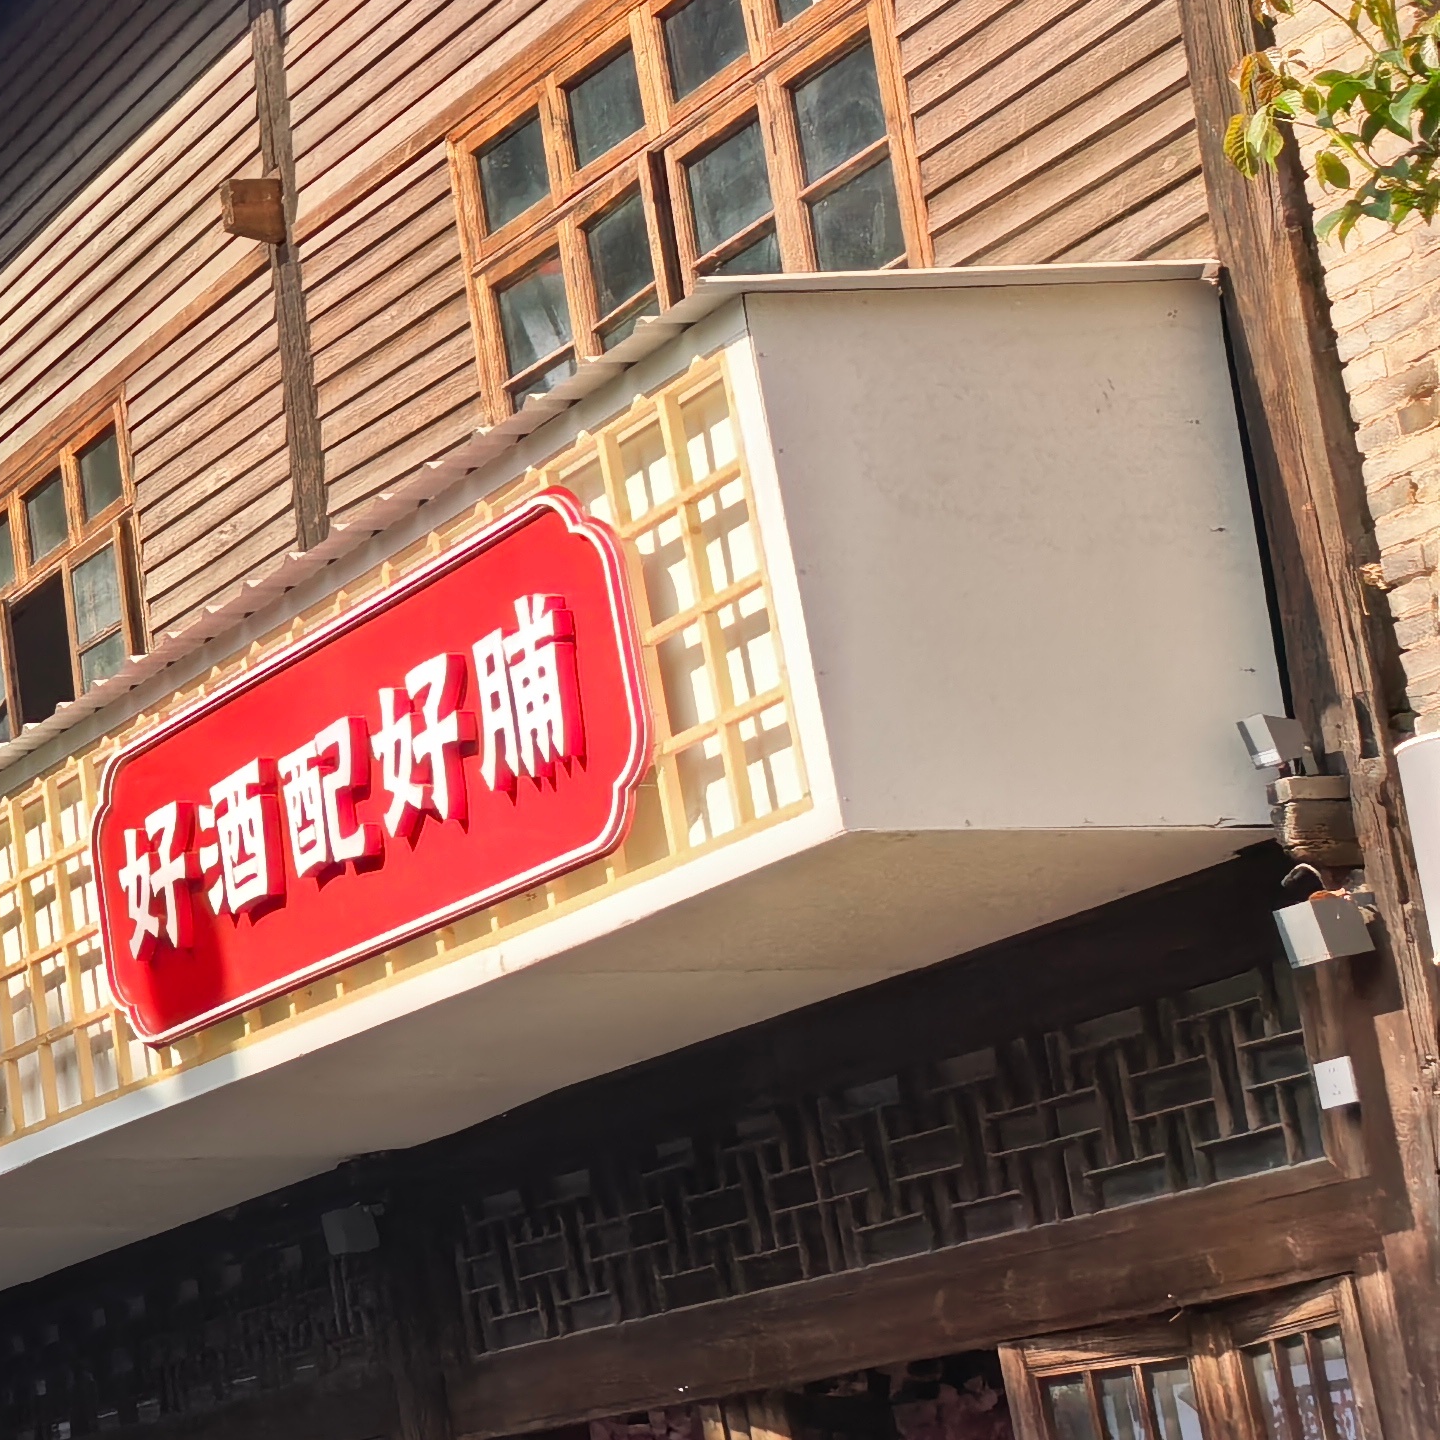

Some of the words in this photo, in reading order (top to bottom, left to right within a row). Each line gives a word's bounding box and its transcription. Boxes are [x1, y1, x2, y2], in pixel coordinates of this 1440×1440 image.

[118, 593, 569, 959] 好酒配好脯
